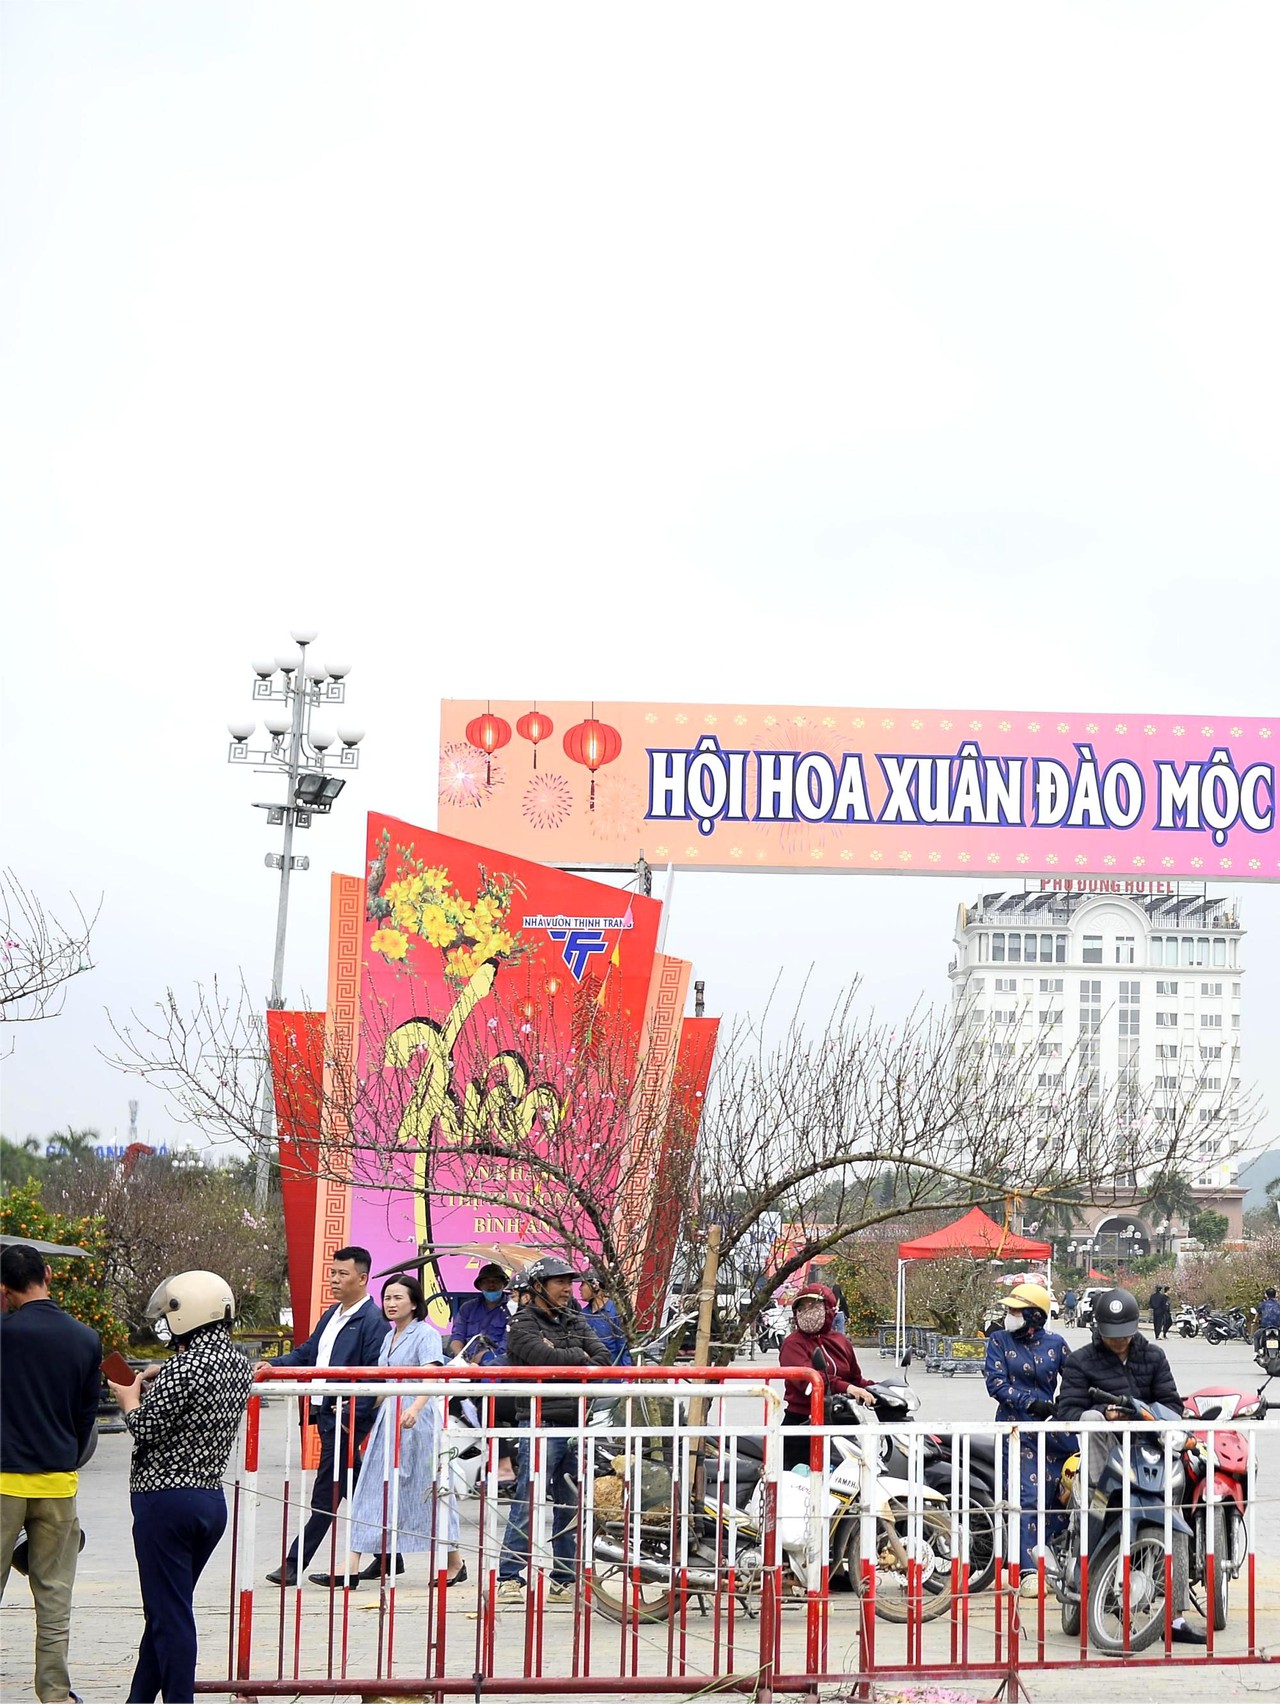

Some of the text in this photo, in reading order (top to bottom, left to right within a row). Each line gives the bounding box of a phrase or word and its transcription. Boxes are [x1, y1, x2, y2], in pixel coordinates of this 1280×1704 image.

[645, 734, 747, 836] HỘI
[752, 748, 872, 822] HOA
[874, 740, 1030, 827] XUÂN
[1029, 743, 1146, 831] ĐÀO
[1154, 747, 1275, 848] MỘC
[524, 915, 543, 928] NHÀ
[473, 1212, 520, 1234] BÌNH
